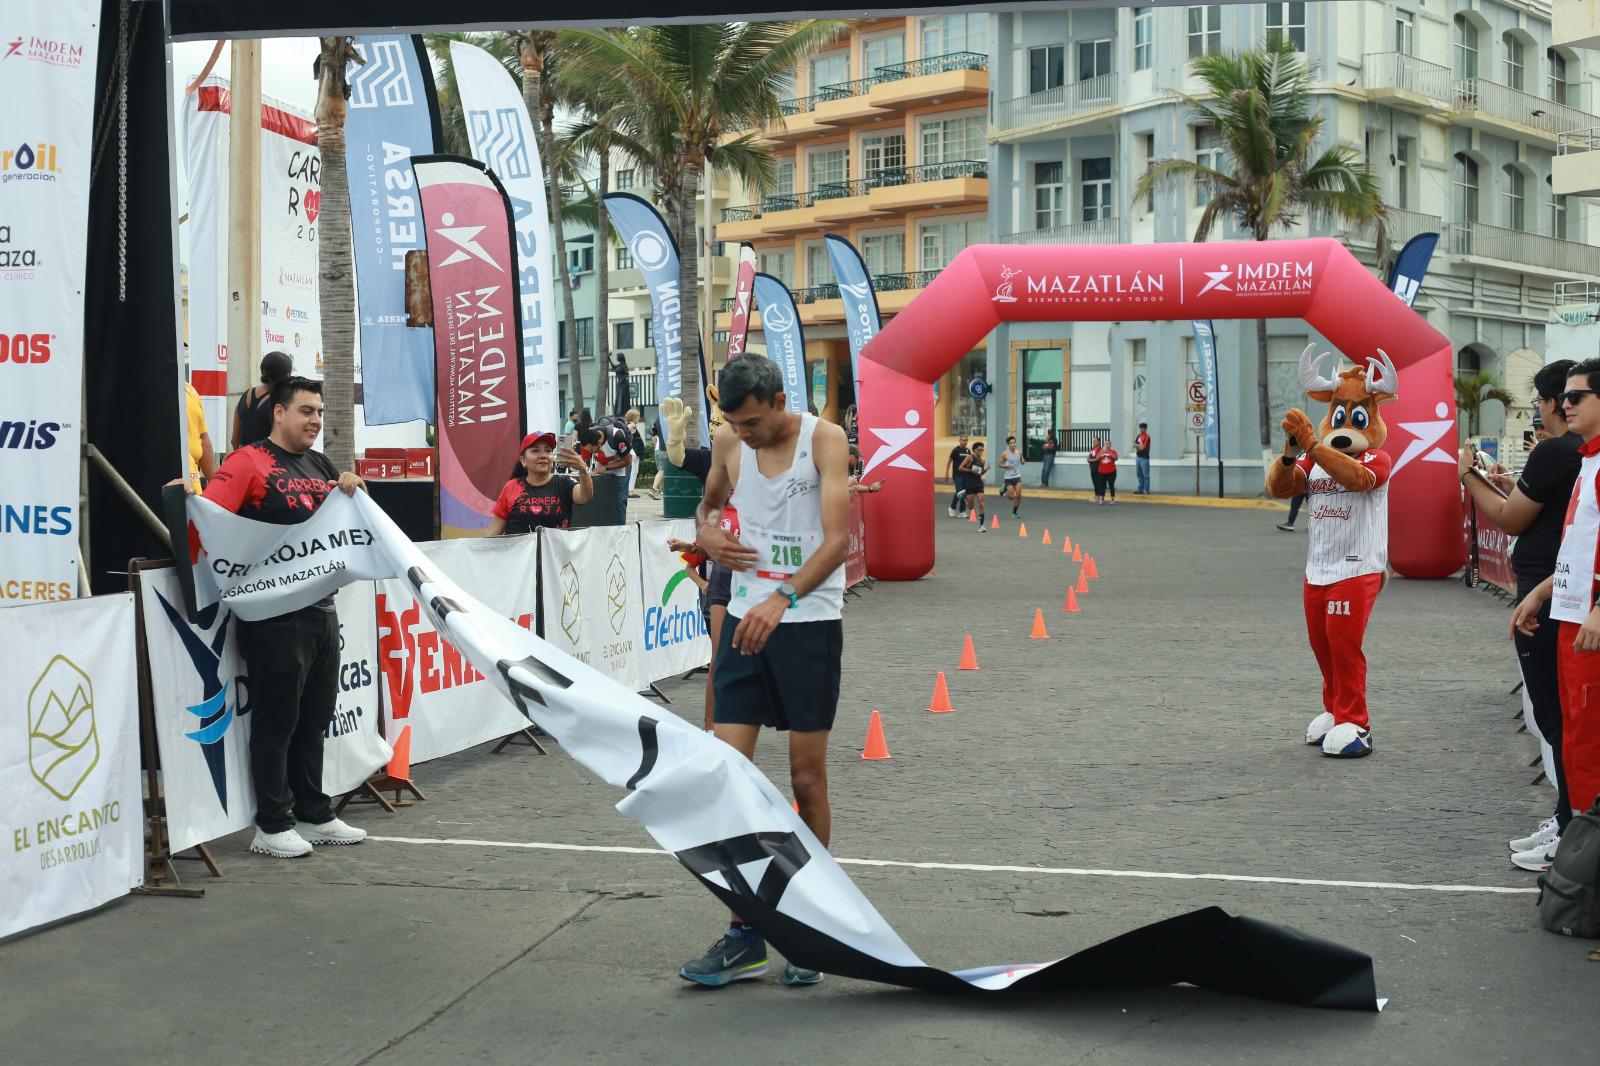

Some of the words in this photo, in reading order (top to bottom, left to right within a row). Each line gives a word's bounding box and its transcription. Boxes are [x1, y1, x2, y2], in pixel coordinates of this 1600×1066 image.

[30, 36, 83, 56] IMDEM
[0, 142, 57, 172] roil
[288, 151, 322, 186] CAR
[1026, 269, 1164, 293] MAZATLÁN
[1236, 260, 1313, 280] IMDEM
[1236, 276, 1313, 292] MAZATLÁN
[381, 463, 387, 478] 3
[425, 455, 432, 476] 1
[771, 544, 802, 567] 216
[279, 560, 346, 586] MAZATLÁN
[1327, 600, 1351, 616] 911
[337, 659, 372, 693] cas
[14, 826, 32, 853] EL
[36, 800, 120, 845] ENCANTO
